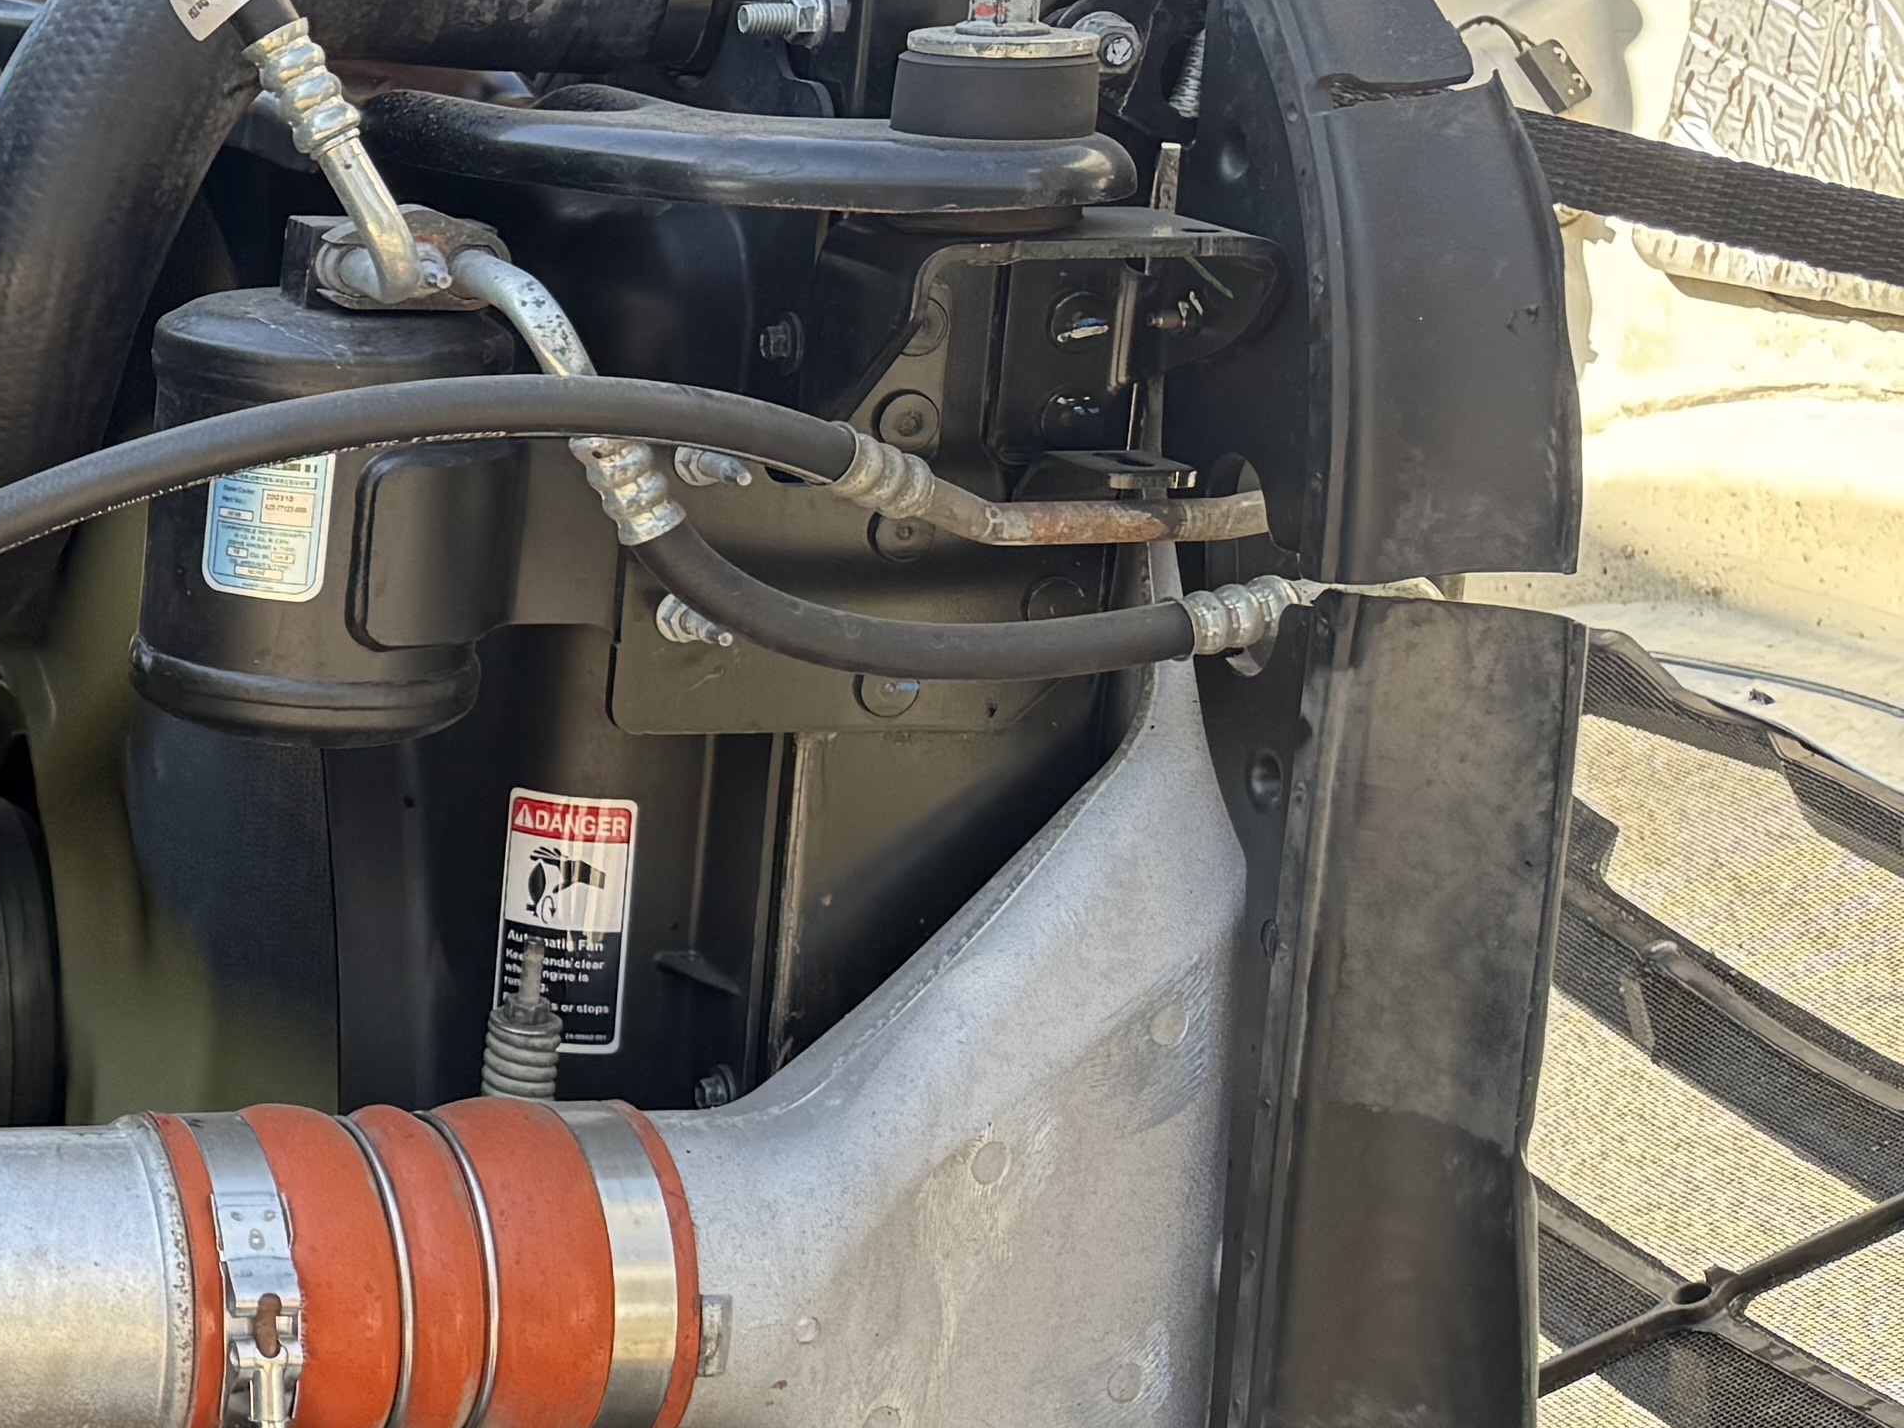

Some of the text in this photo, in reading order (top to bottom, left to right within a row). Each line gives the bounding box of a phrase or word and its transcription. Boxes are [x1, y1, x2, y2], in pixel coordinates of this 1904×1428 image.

[535, 811, 627, 838] DANGER
[507, 929, 604, 952] Autatic Fan
[505, 948, 605, 970] Kee ands clear
[542, 970, 576, 982] ngine
[578, 972, 590, 982] is
[560, 1003, 609, 1015] or stops
